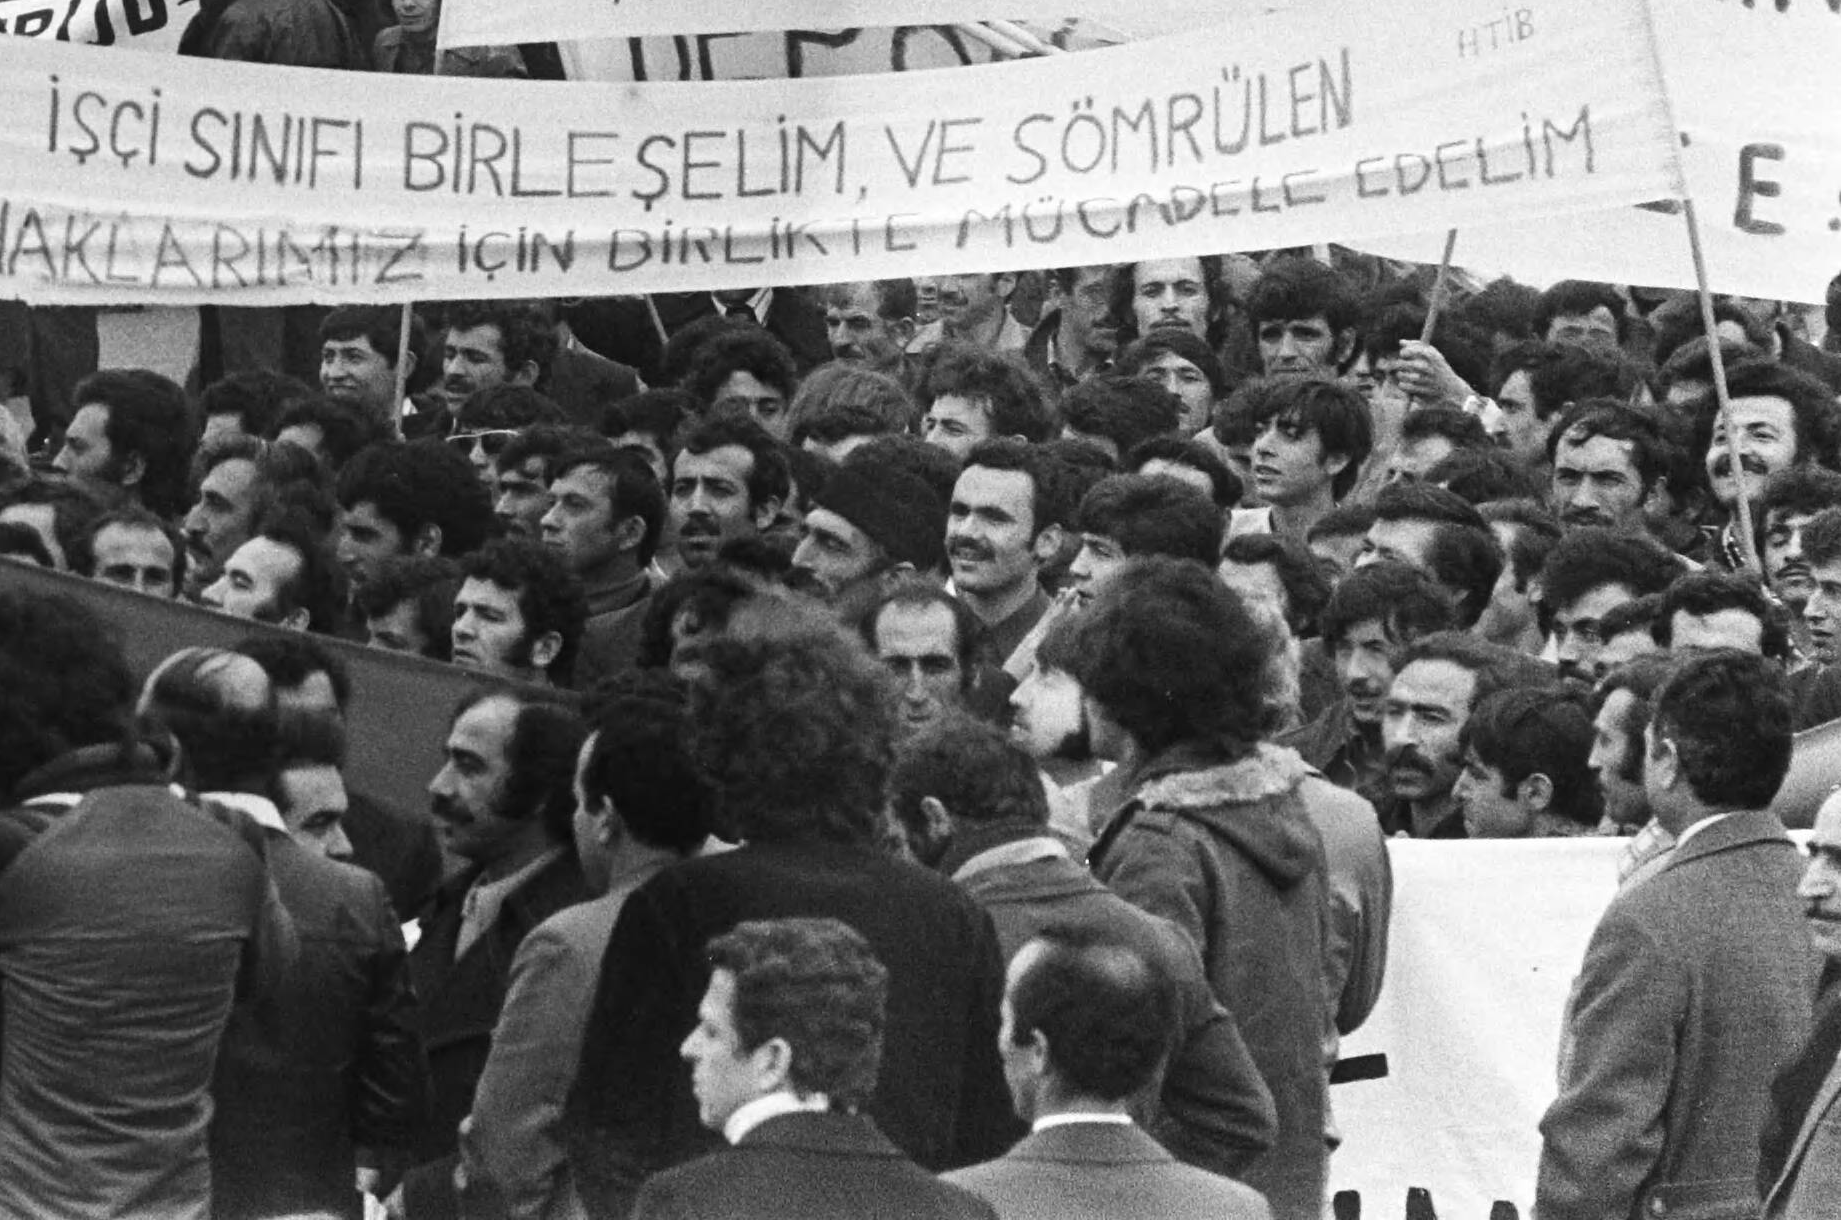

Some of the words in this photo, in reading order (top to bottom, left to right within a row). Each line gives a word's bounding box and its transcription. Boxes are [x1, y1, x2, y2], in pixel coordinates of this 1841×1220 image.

[46, 73, 163, 168] İŞÇİ
[183, 107, 363, 191] SINIFI
[884, 116, 984, 190] VE
